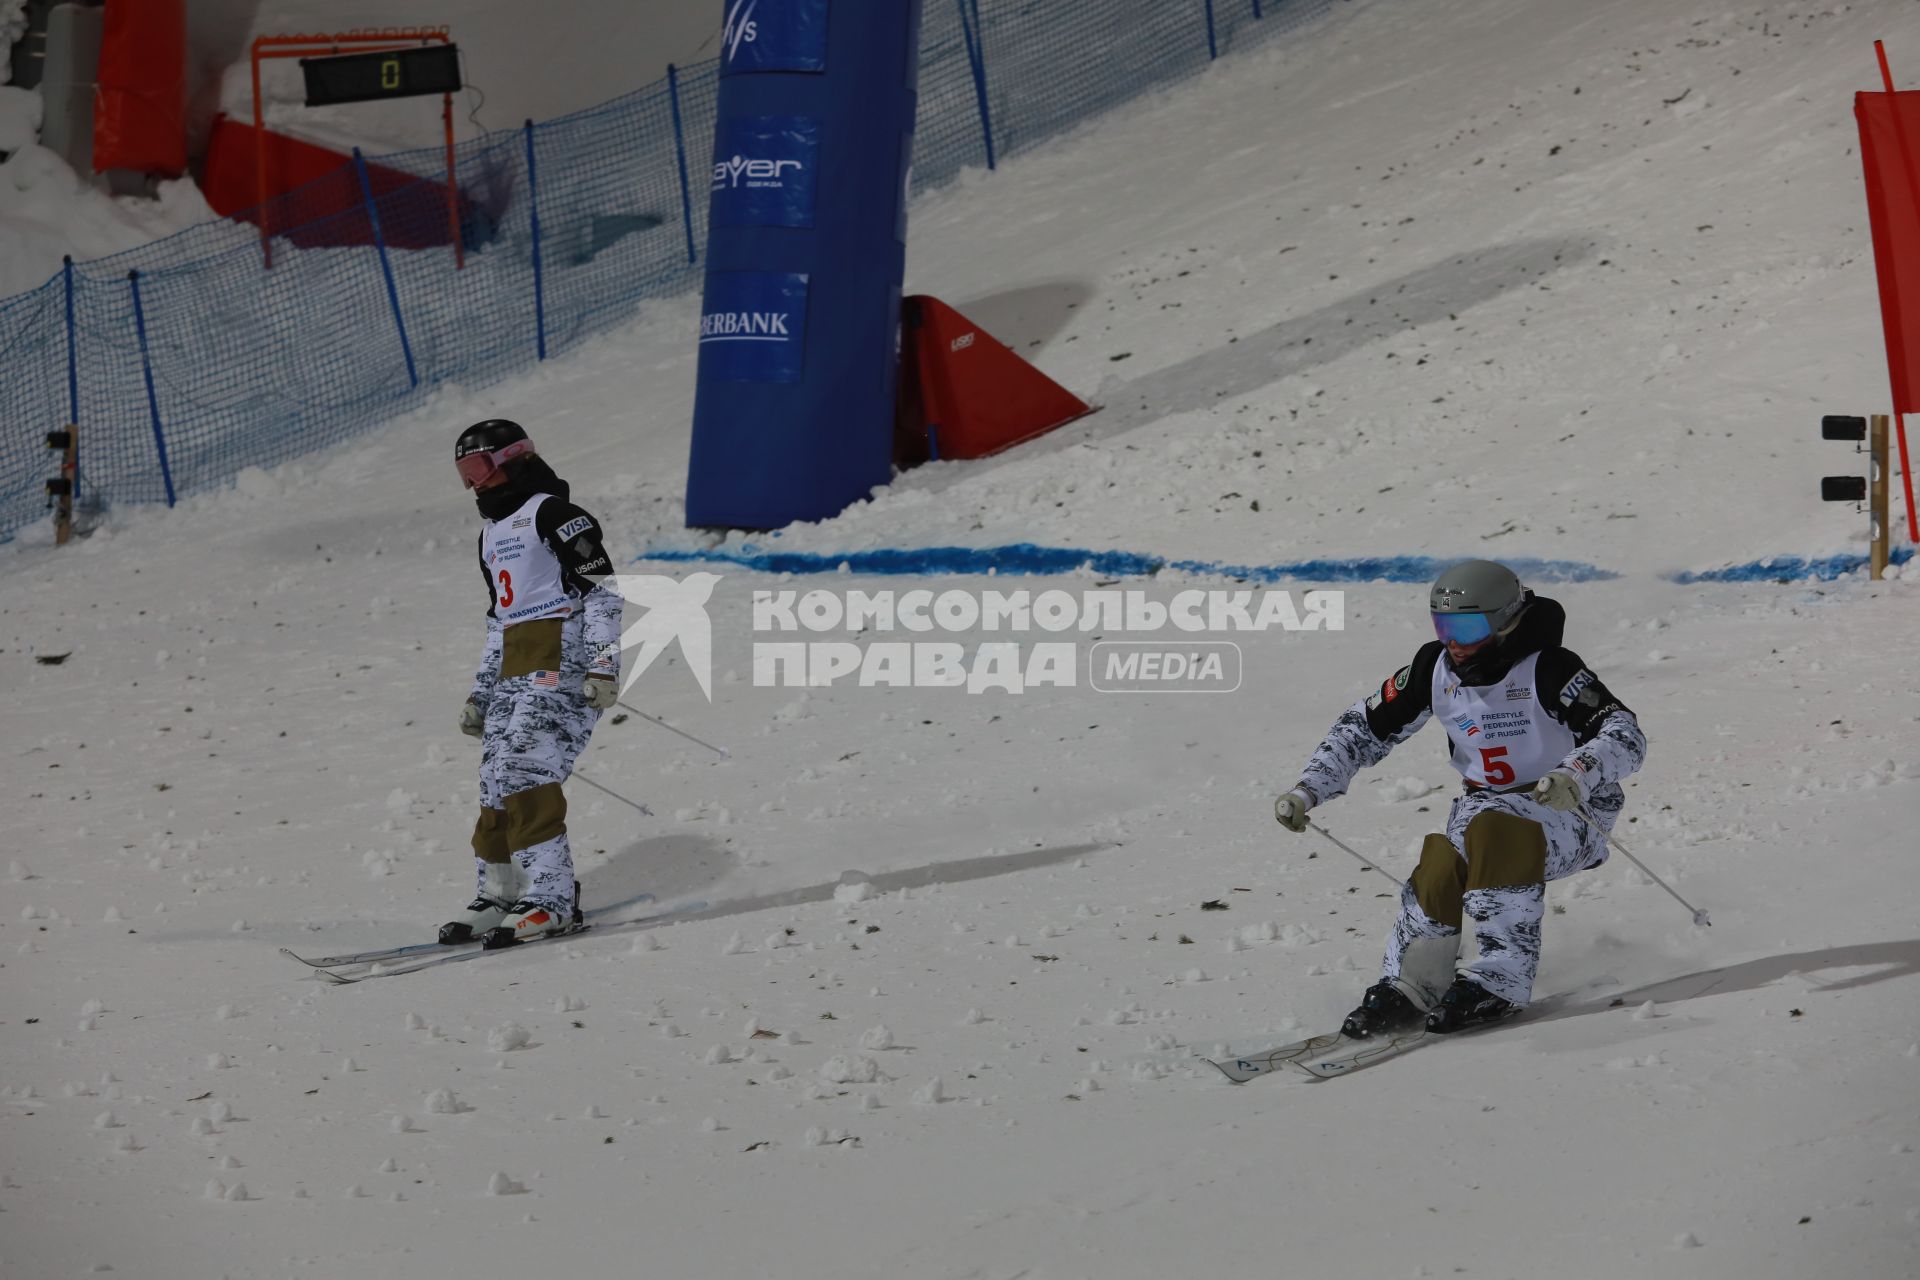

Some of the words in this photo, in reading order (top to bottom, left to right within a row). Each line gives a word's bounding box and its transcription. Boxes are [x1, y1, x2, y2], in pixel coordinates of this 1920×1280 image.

[382, 60, 399, 89] 0
[560, 518, 591, 538] VISA
[495, 536, 521, 546] FREESTYLE
[504, 552, 521, 561] RUSSIA
[498, 570, 514, 608] 3
[508, 596, 567, 619] KRASNOYARSK
[1561, 671, 1594, 702] VISA
[1481, 711, 1525, 721] FREESTYLE
[1483, 719, 1531, 730] FEDERATION
[1485, 732, 1496, 740] OF
[1497, 729, 1527, 738] RUSSIA
[1478, 746, 1516, 786] 5
